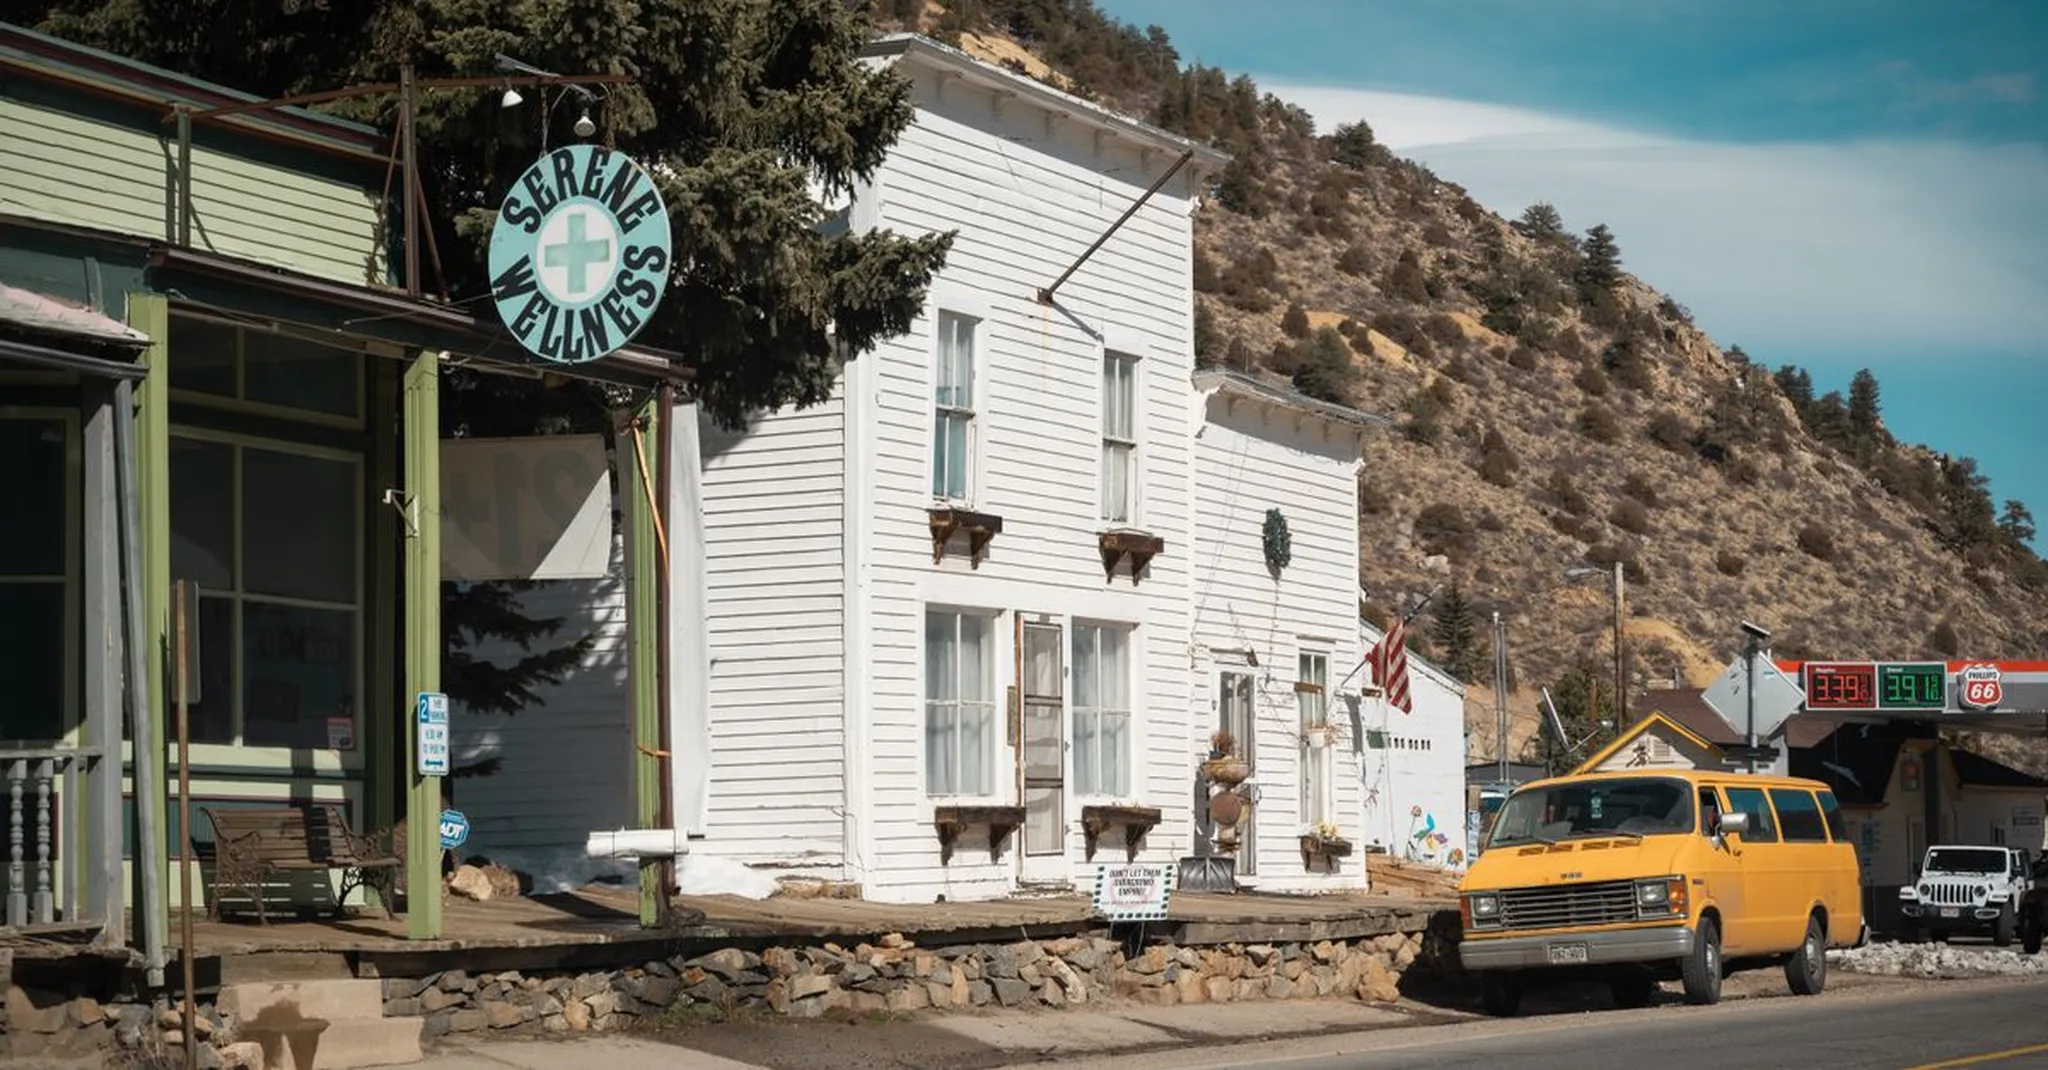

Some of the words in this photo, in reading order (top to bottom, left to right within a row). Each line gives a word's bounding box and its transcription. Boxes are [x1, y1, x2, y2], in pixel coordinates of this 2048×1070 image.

[502, 147, 662, 235] SERENE
[492, 245, 668, 360] WELLNESS
[1968, 671, 1998, 679] PHILLIPS
[1971, 683, 1996, 699] 66
[420, 699, 427, 720] 2
[441, 821, 465, 839] ADT
[1109, 869, 1128, 878] DON'T
[1130, 868, 1142, 877] LET
[1143, 868, 1161, 877] THEM
